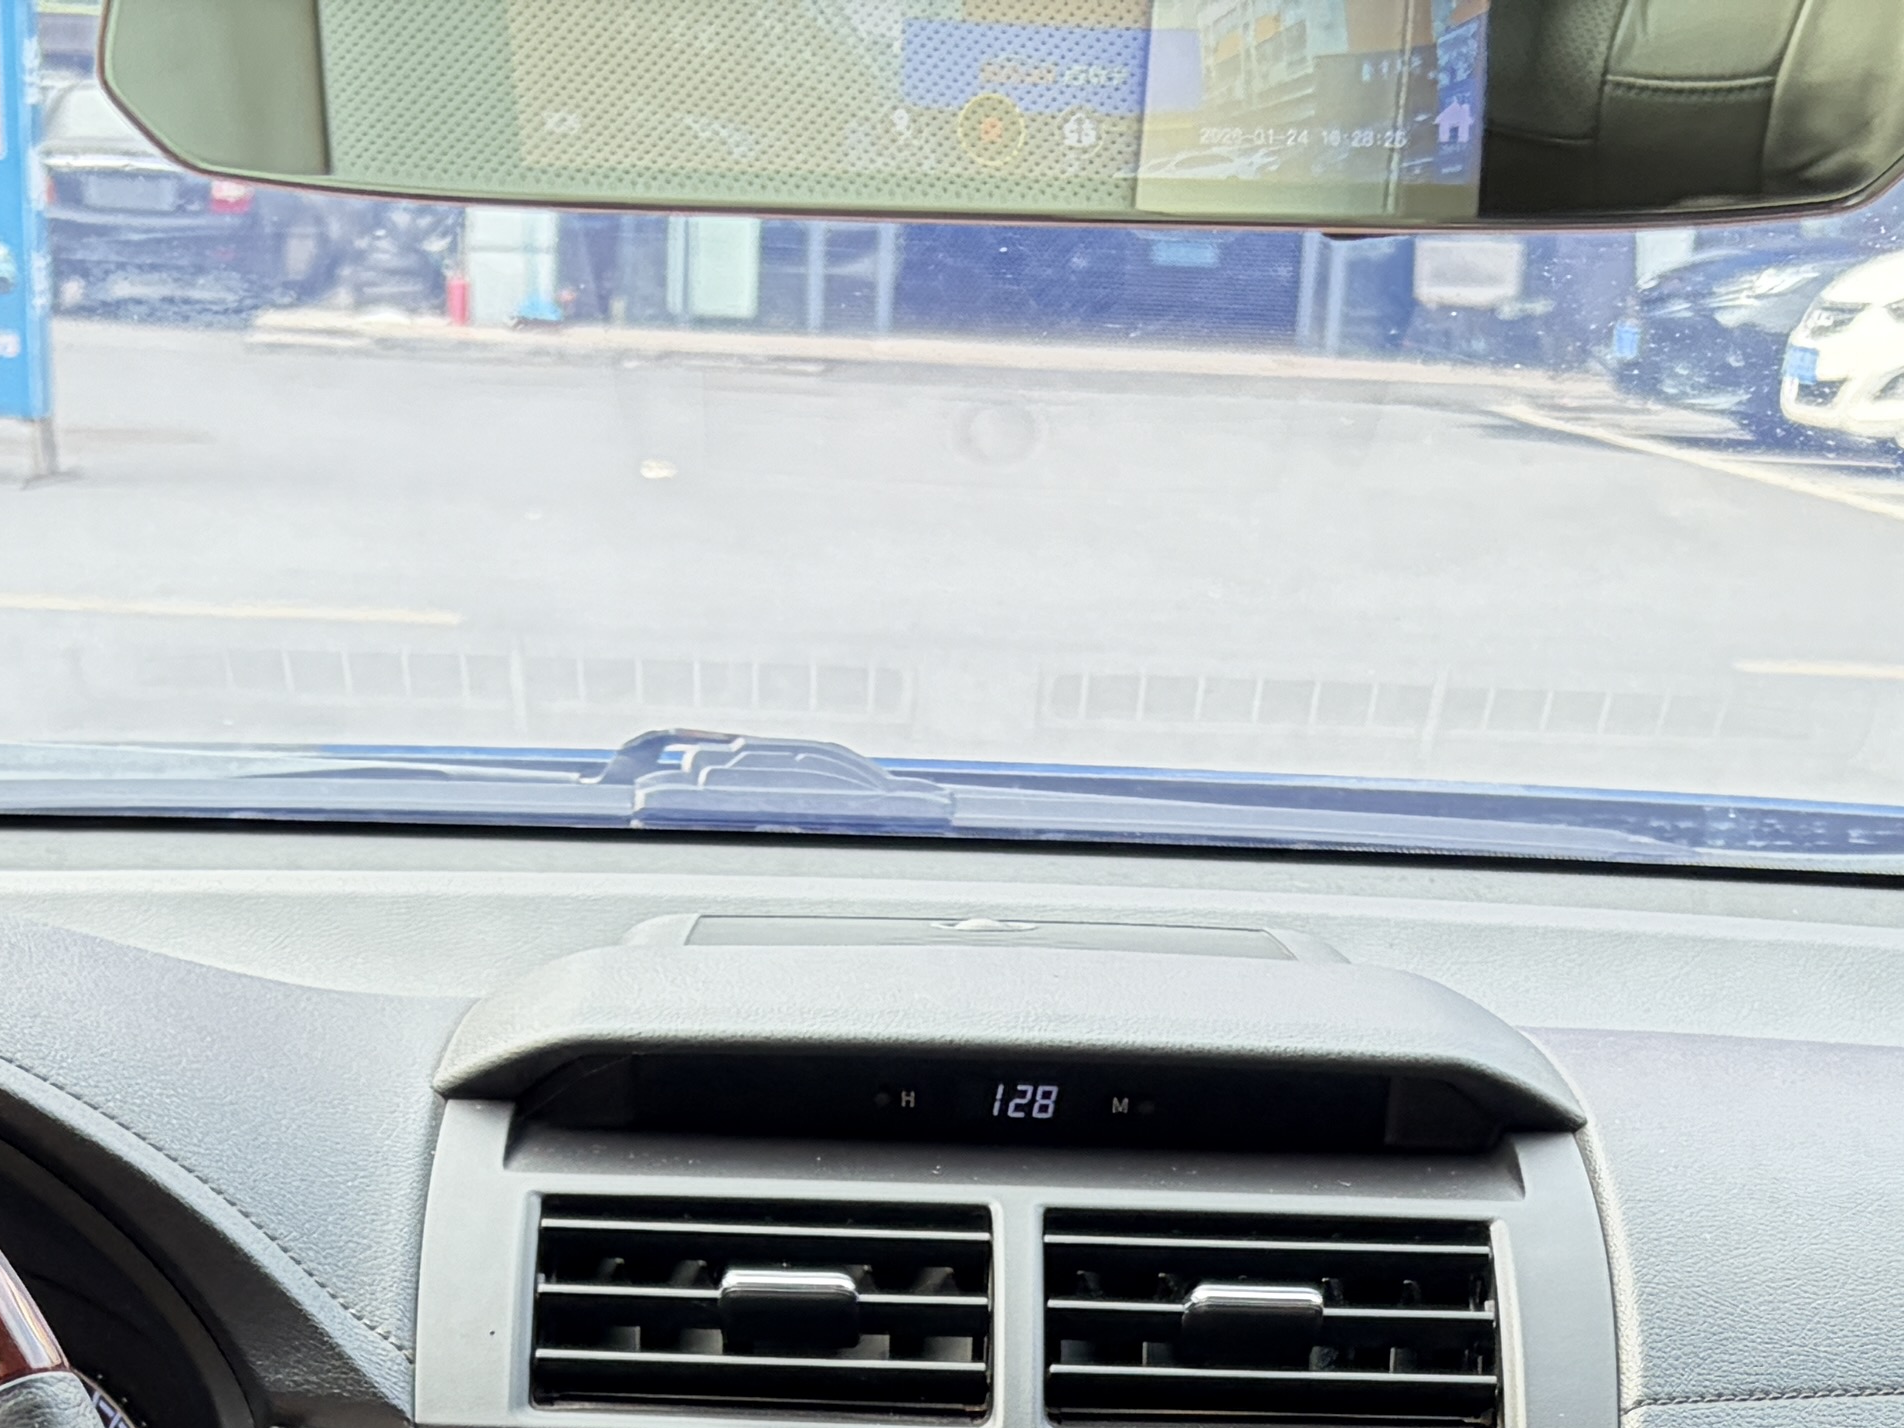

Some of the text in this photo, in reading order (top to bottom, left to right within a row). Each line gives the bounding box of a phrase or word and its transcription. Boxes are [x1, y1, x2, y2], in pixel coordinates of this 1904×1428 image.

[901, 1090, 915, 1108] H
[992, 1083, 1059, 1119] 128
[1112, 1096, 1129, 1113] M
